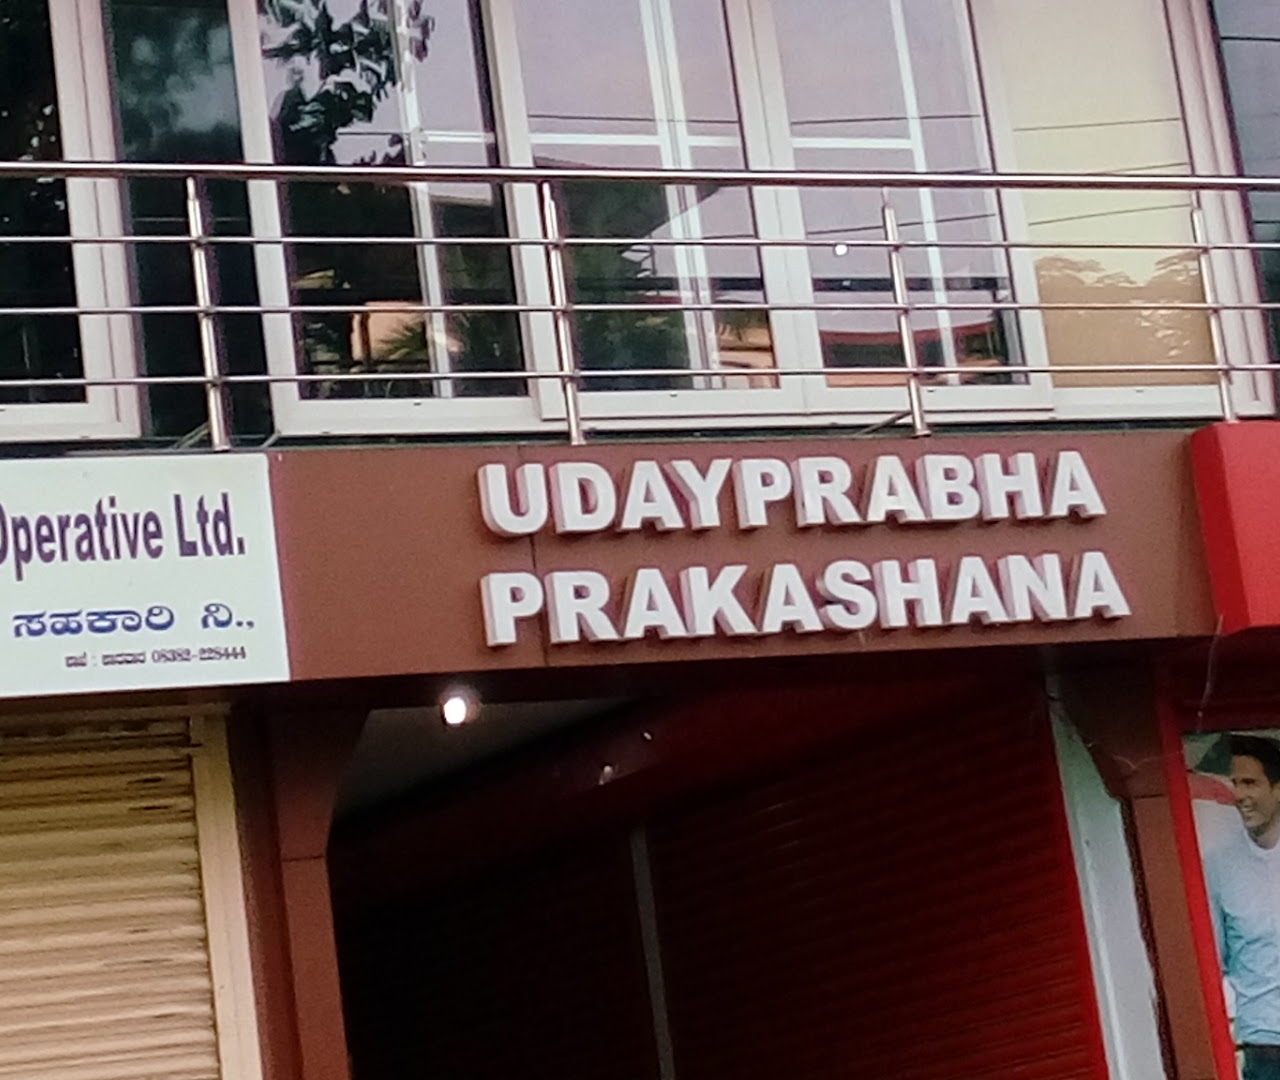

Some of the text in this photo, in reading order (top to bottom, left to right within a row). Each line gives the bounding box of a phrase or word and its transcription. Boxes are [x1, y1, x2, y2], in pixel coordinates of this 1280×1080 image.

[175, 491, 246, 559] Ltd.
[477, 450, 1107, 537] UDAYPRABHA
[12, 601, 176, 640] ಸಹಕಾರಿ
[480, 550, 1132, 647] PRAKASHANA
